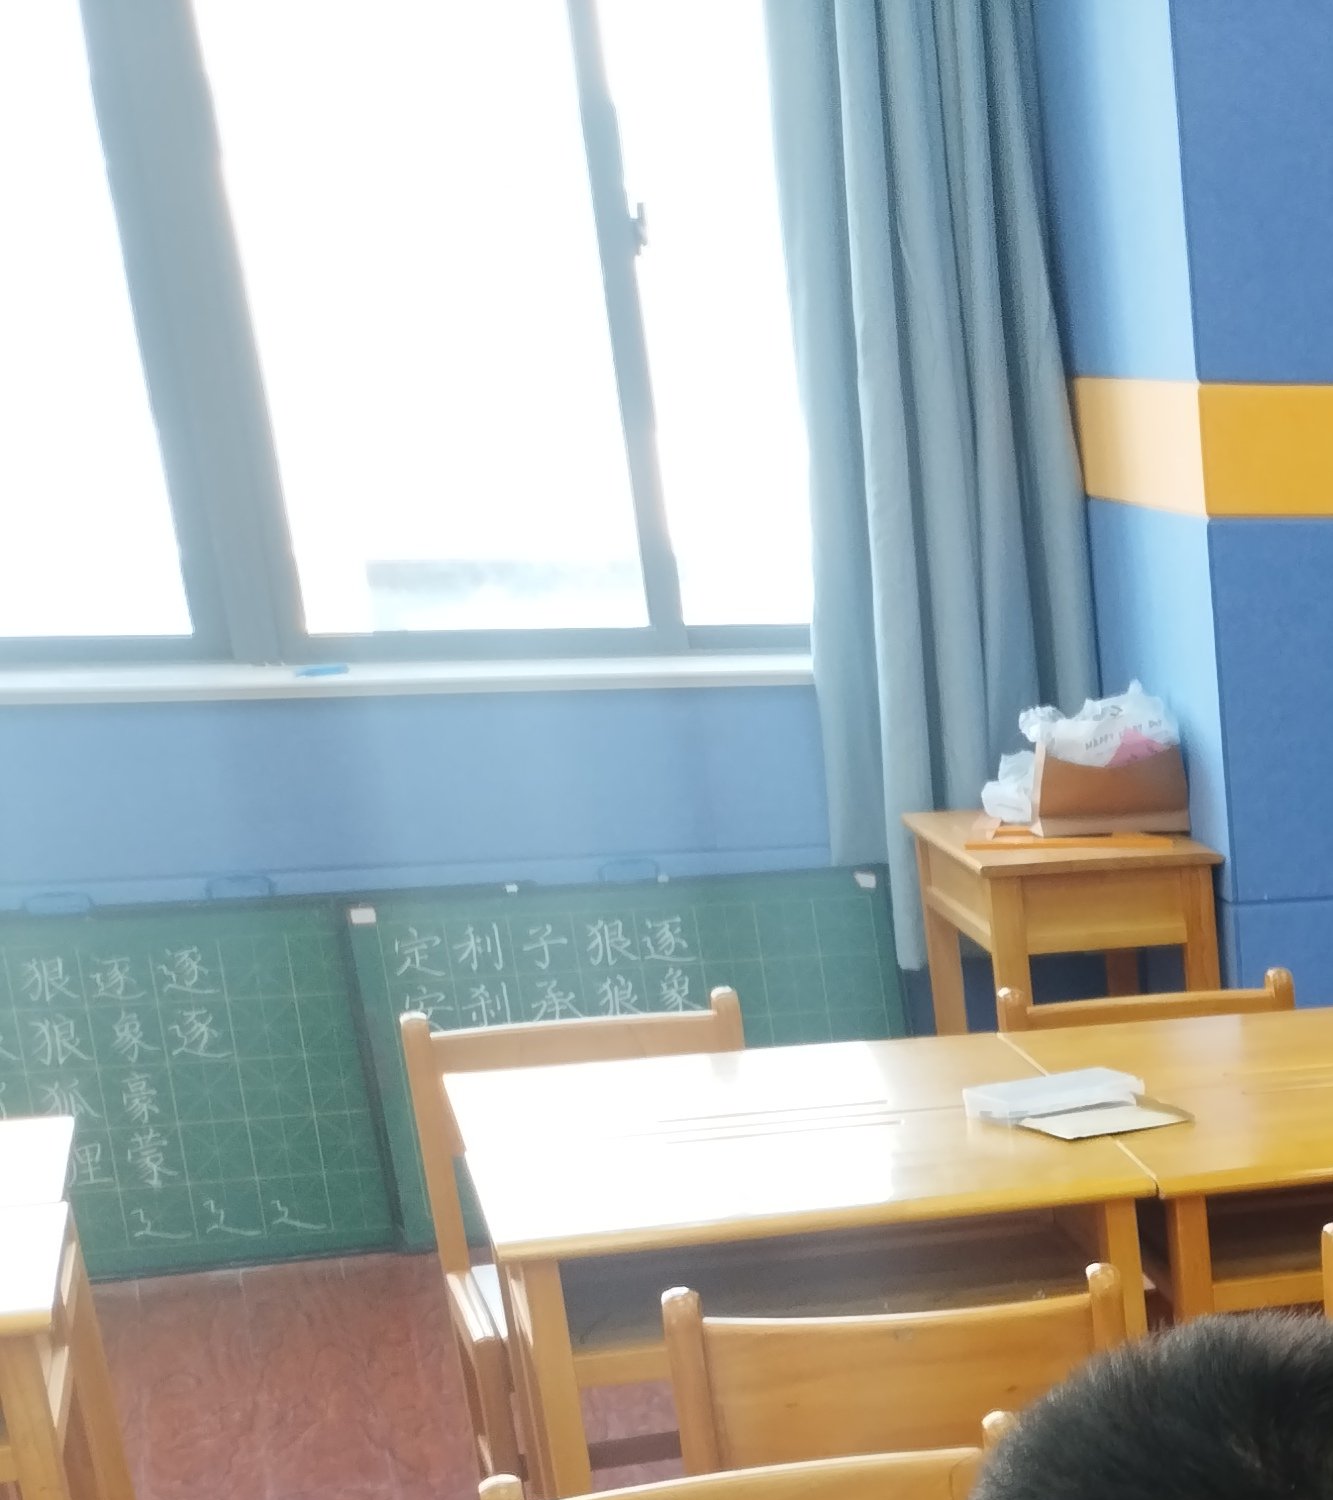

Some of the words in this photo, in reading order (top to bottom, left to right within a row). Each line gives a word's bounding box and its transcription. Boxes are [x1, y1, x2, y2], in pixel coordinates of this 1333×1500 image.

[395, 915, 697, 977] 定利子狠逐
